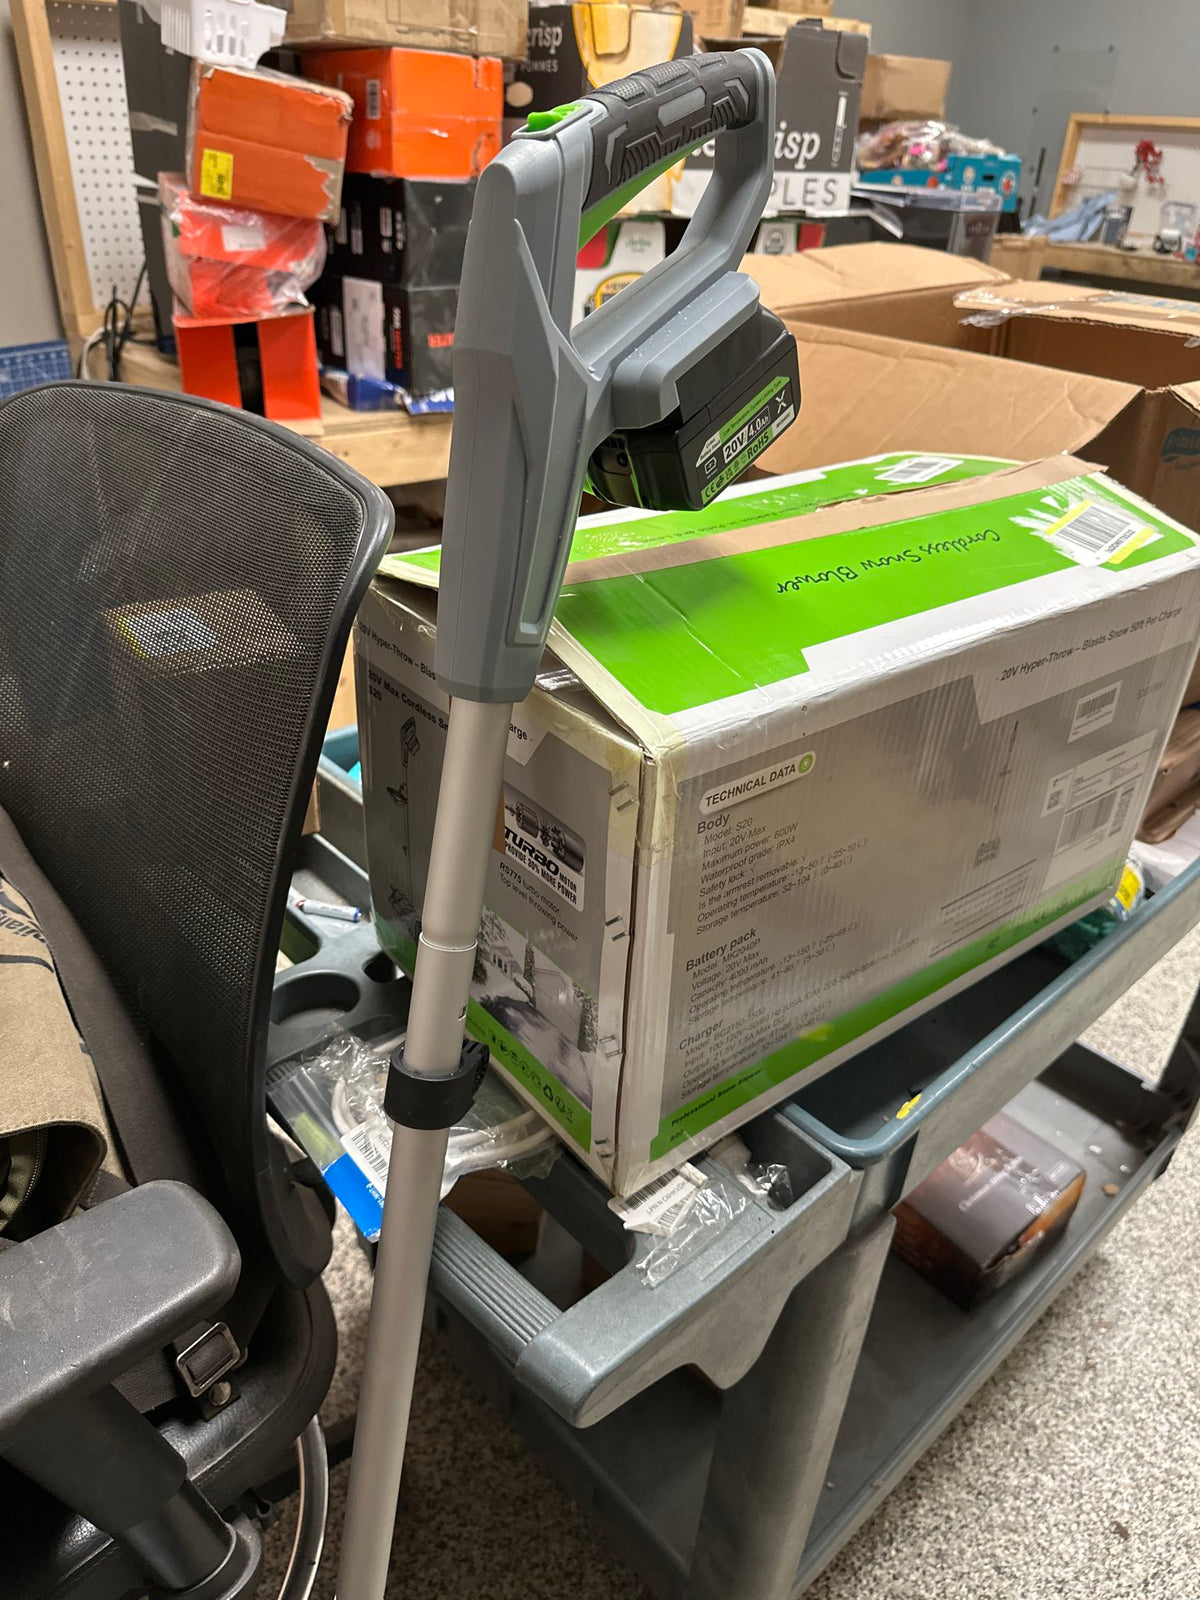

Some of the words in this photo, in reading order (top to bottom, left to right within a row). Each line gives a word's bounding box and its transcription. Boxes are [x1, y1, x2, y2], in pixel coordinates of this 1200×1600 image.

[747, 431, 769, 460] RoHS
[922, 528, 1001, 555] Cordless
[861, 548, 921, 571] Snow
[777, 565, 859, 594] Blower
[1000, 666, 1020, 682] 20V
[1020, 648, 1075, 675] Hyper-Throw
[1081, 634, 1107, 652] Blasts
[1107, 626, 1129, 641] Snow
[368, 669, 383, 687] 20V
[383, 681, 400, 699] Max
[401, 692, 437, 725] Cordless
[371, 630, 414, 666] Hyper-Throw
[420, 662, 437, 681] Blas
[508, 721, 528, 741] arge
[705, 776, 767, 808] TECHNICAL
[768, 764, 797, 783] DATA
[697, 813, 731, 835] Body
[704, 829, 732, 846] Model:
[735, 817, 753, 833] S20
[701, 849, 743, 873] Maximum
[774, 822, 799, 841] 600W
[702, 841, 728, 859] Input:
[729, 832, 747, 847] 20V
[748, 824, 767, 839] Max
[504, 825, 560, 877] TURBO
[559, 871, 578, 895] MOTOR
[700, 858, 748, 885] Waterproof
[540, 868, 557, 890] MORE
[557, 880, 578, 906] POWER
[699, 880, 727, 898] Safety
[708, 893, 722, 906] the
[723, 878, 756, 899] armrest
[528, 894, 557, 927] throwing
[556, 918, 579, 943] power
[696, 914, 729, 936] Storage
[697, 898, 738, 923] Operating
[685, 942, 727, 972] Battery
[728, 927, 758, 952] pack
[724, 959, 742, 974] 20V
[743, 950, 761, 965] Max
[691, 962, 718, 980] Model:
[728, 965, 749, 982] 4000
[749, 956, 769, 972] mAh
[688, 989, 729, 1015] Operating
[679, 1019, 725, 1050] Charger
[671, 1094, 718, 1128] Professional
